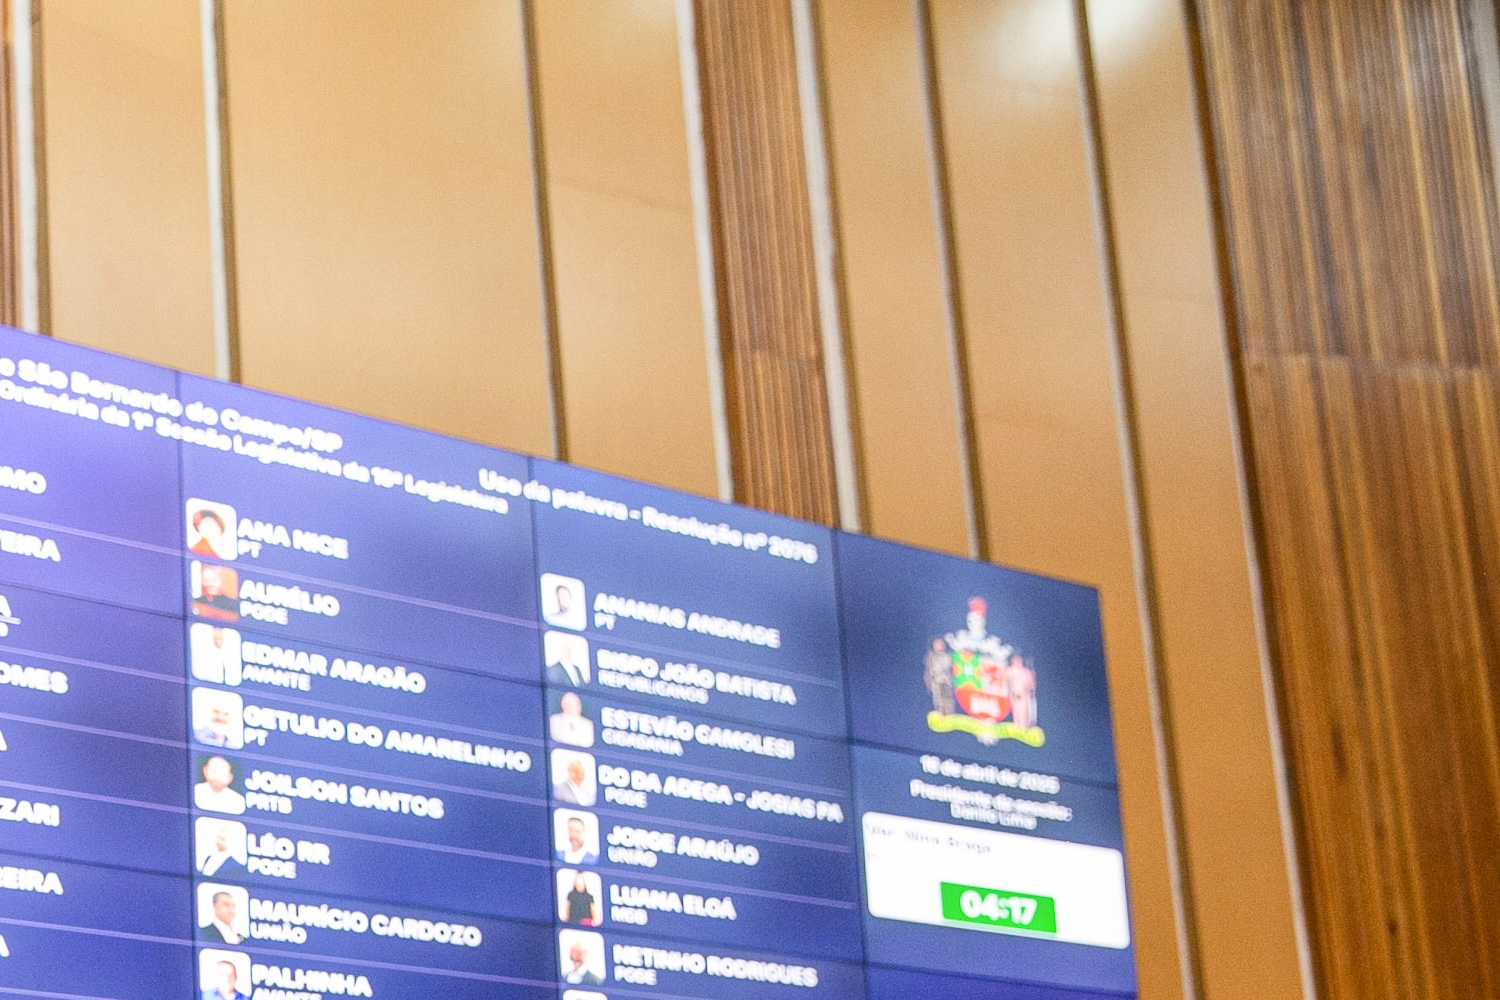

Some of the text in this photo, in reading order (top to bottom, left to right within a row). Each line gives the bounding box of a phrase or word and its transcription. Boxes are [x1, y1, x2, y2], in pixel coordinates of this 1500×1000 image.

[18, 359, 68, 389] São
[71, 371, 183, 417] Bernardo
[236, 518, 349, 559] ANA NICE
[237, 539, 262, 558] PT
[239, 579, 340, 616] AURÉLIO
[240, 601, 288, 625] PODE
[594, 593, 780, 648] ANANIAS ANDRADE
[594, 612, 616, 630] PT
[241, 641, 426, 693] EDMAR ARAGÃO
[242, 664, 310, 691] AVANTE
[597, 649, 796, 705] BISPO JOÃO BATISTA
[243, 727, 268, 746] PT
[243, 705, 531, 772] GETULIO DO AMARELINHO
[601, 707, 795, 759] ESTEVÃO CAMOLESI
[245, 770, 444, 819] JOILSON SANTOS
[245, 792, 292, 814] PRTB
[662, 776, 733, 805] ADEGA
[746, 790, 817, 818] JOSIAS
[247, 832, 295, 859] LÉO
[607, 825, 759, 865] JORGE ARAÚJO
[247, 856, 296, 879] PODE
[610, 884, 737, 920] LUANA ELOÁ
[960, 890, 1037, 924] 04:17
[249, 898, 482, 947] MAURÍCIO CARDOZO
[249, 922, 307, 944] UNIÃO
[251, 964, 373, 997] PALHINHA
[613, 944, 818, 987] NETINHO RODRIGUES
